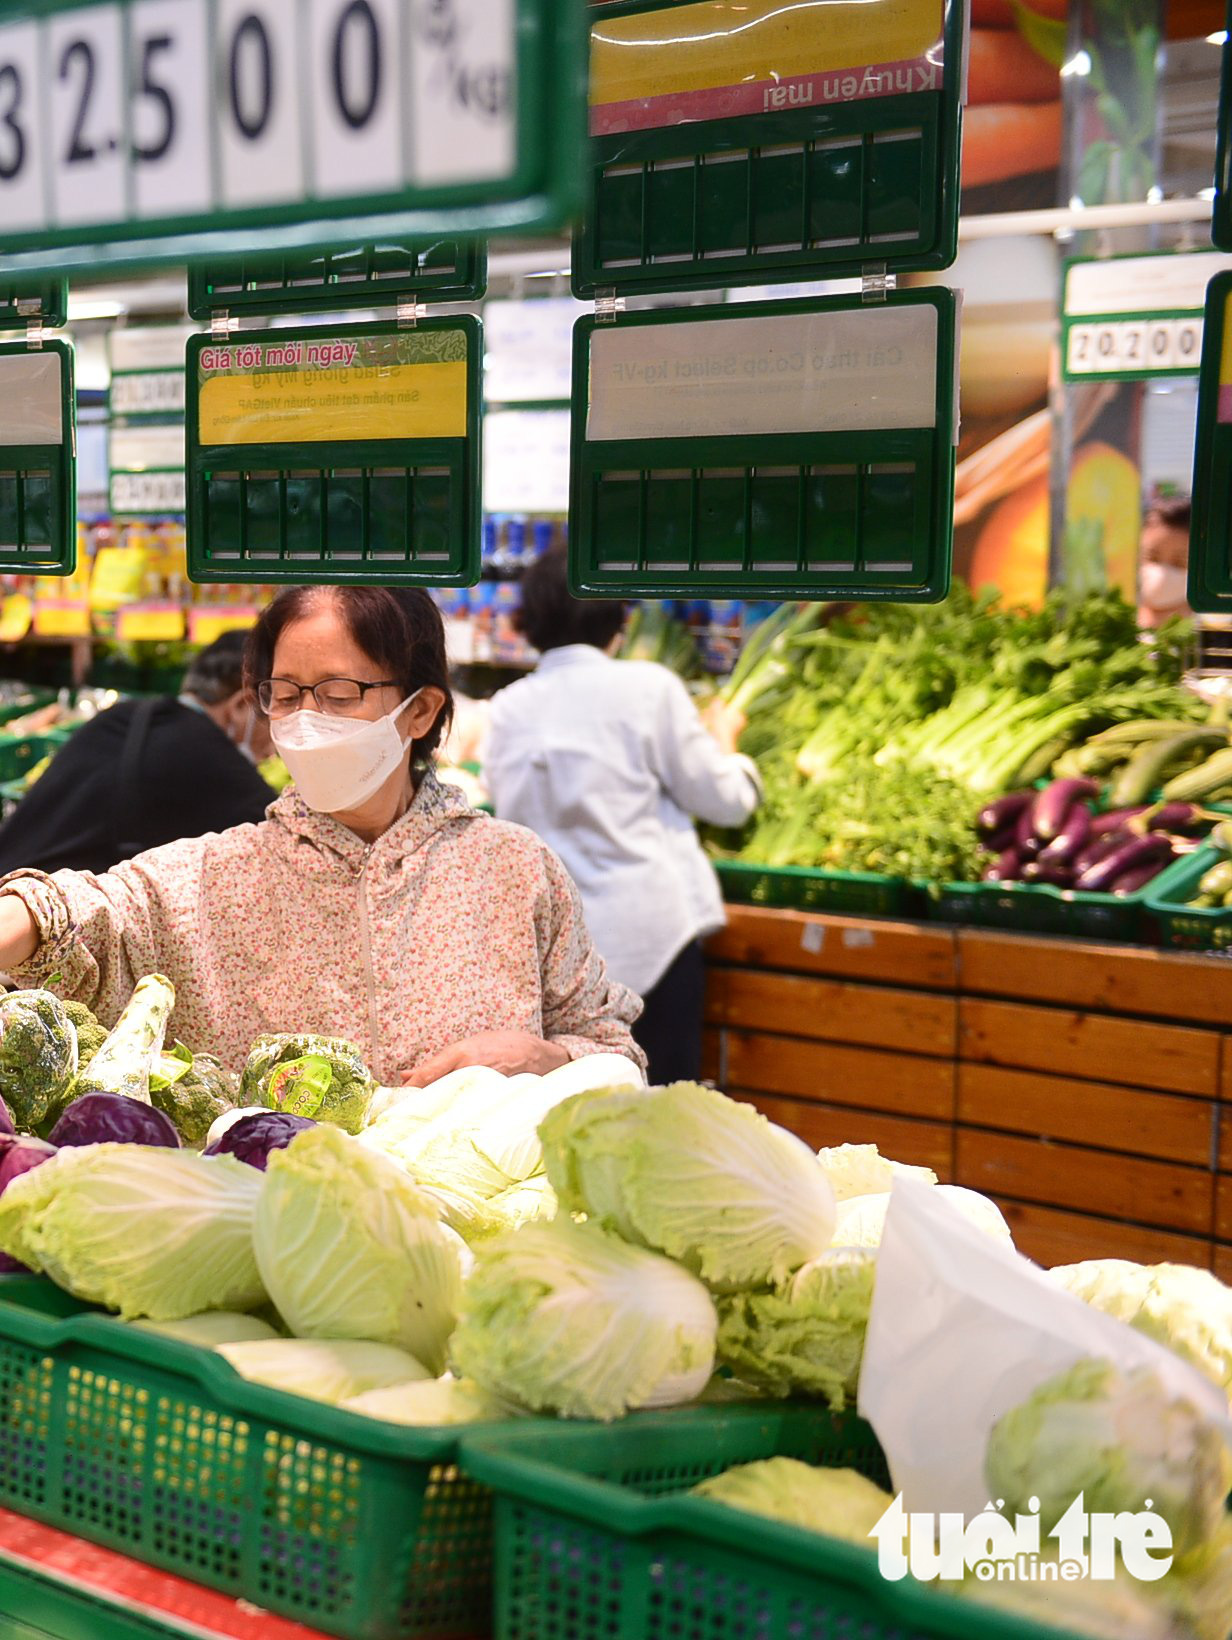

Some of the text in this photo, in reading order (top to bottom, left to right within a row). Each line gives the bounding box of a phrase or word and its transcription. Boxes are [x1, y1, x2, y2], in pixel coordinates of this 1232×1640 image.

[200, 340, 357, 370] Giá tốt mỗi ngày
